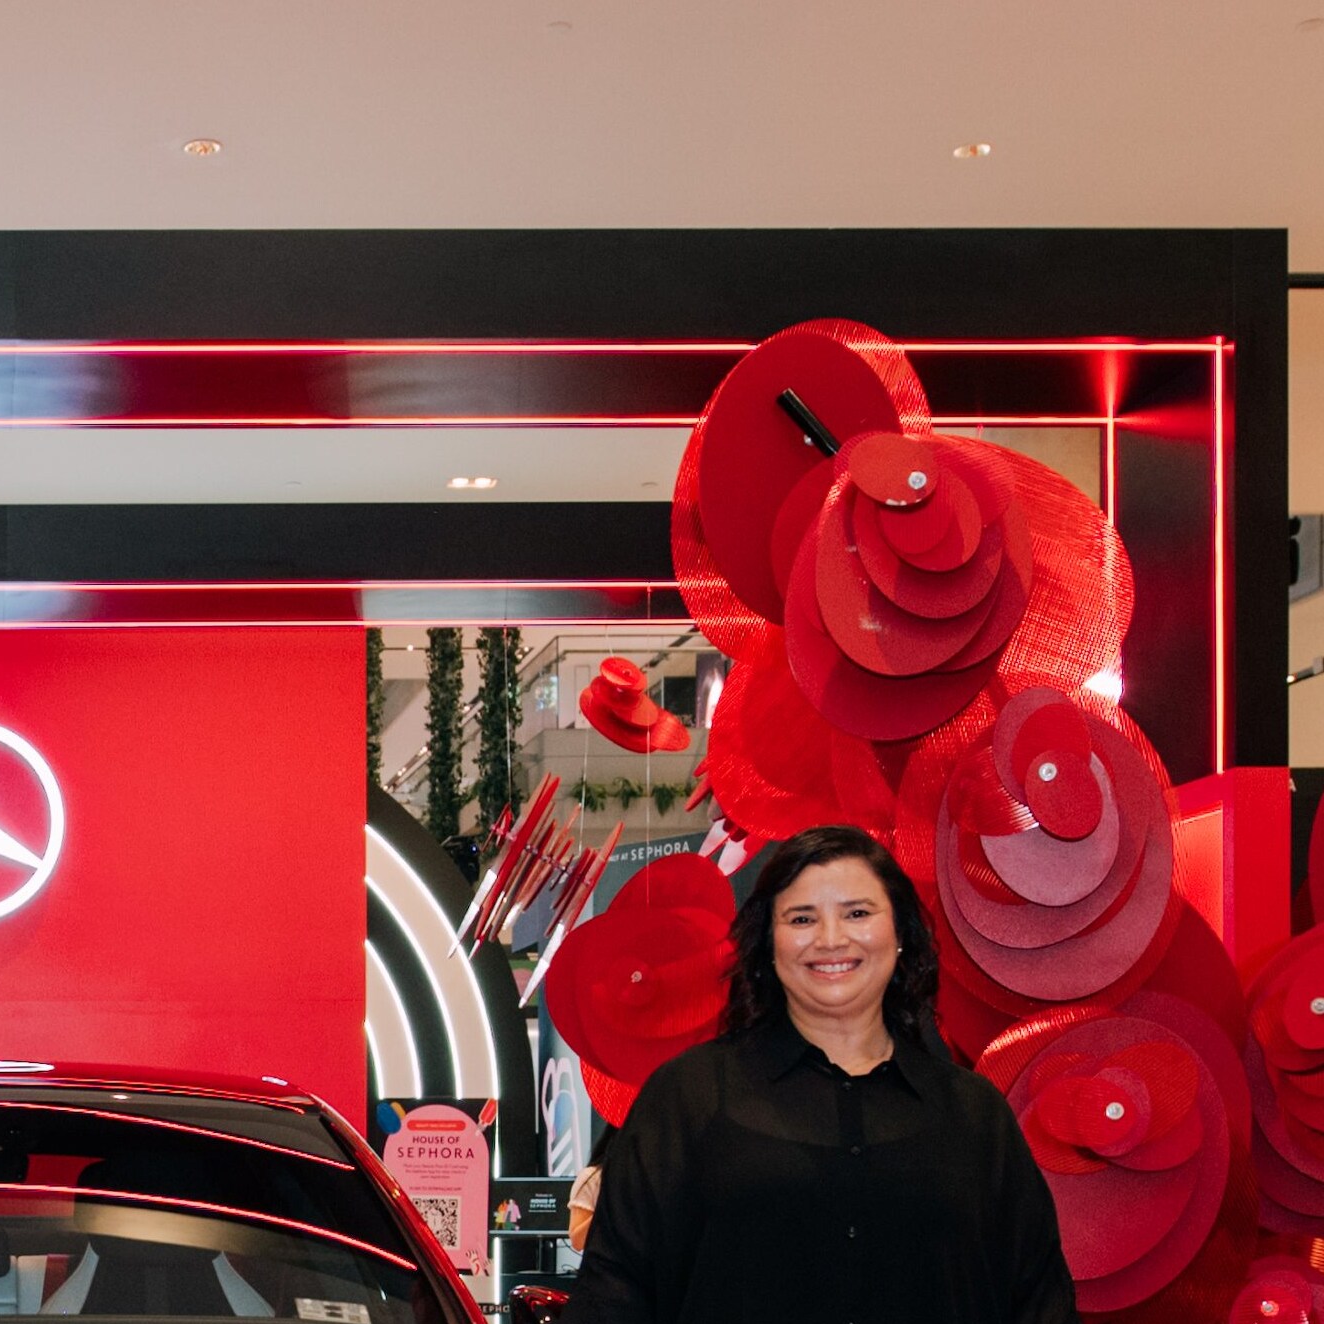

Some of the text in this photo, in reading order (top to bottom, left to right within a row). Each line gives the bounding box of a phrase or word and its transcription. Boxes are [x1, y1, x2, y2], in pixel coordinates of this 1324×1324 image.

[630, 840, 691, 862] SEPHORA
[412, 1136, 460, 1145] HOUSE OF
[397, 1146, 475, 1159] SEPHORA
